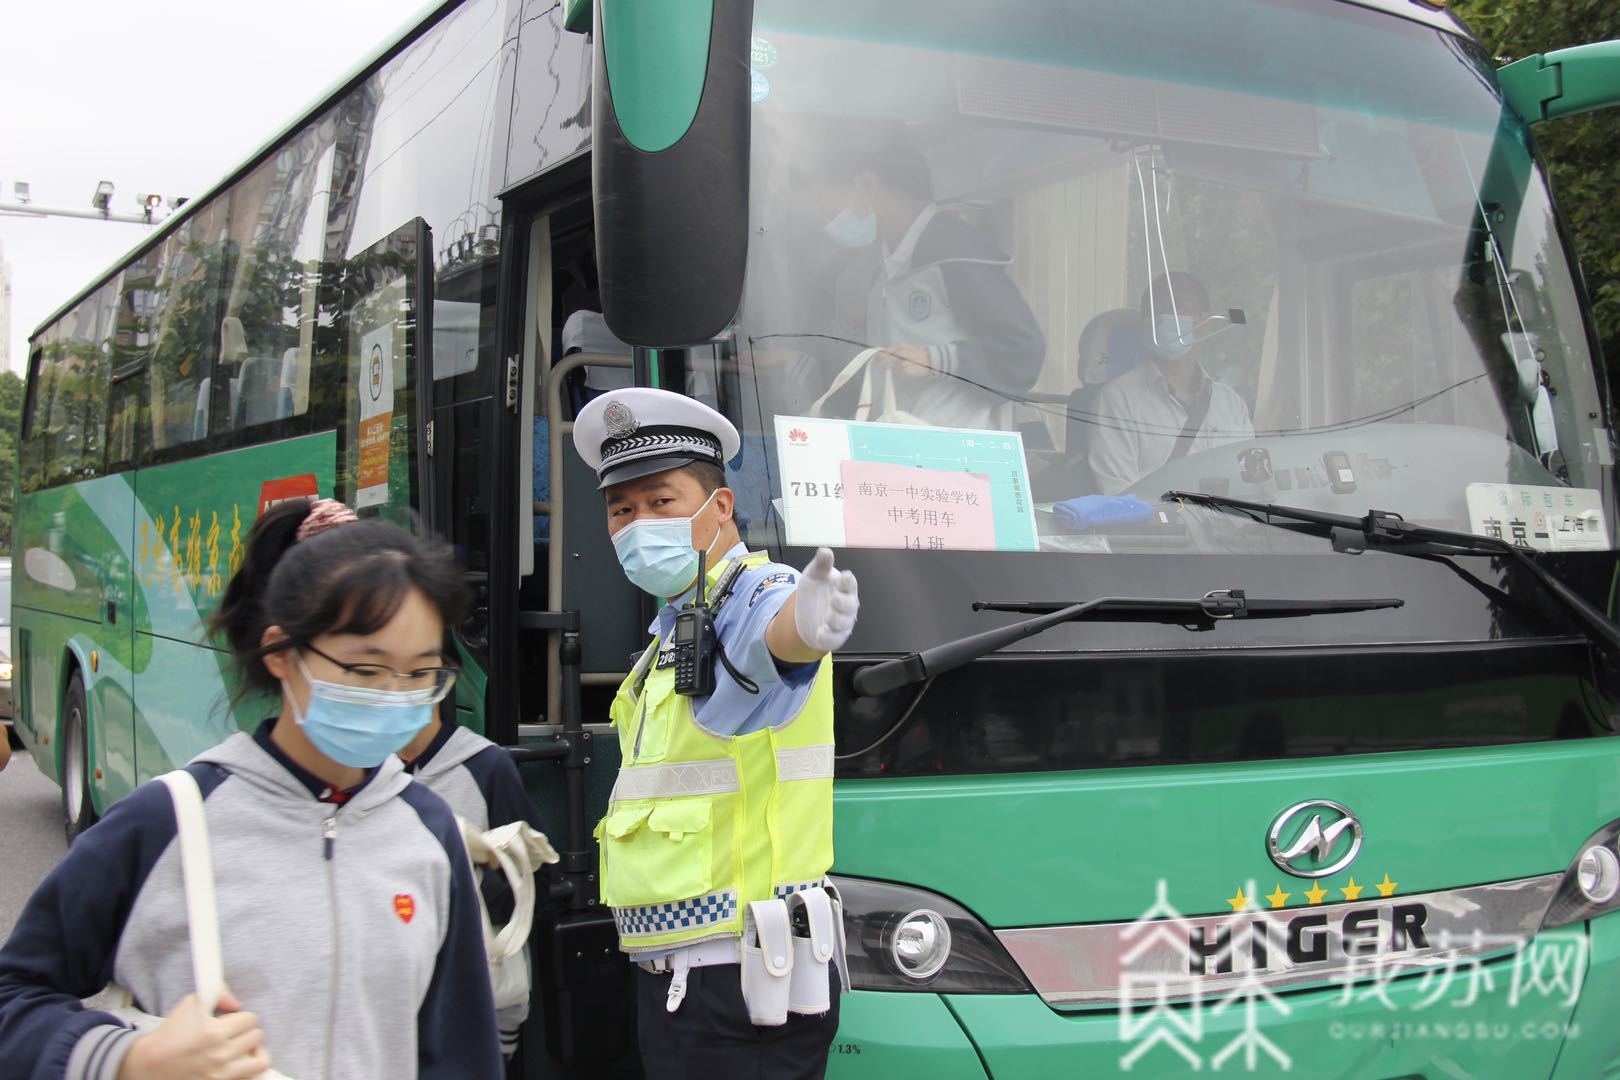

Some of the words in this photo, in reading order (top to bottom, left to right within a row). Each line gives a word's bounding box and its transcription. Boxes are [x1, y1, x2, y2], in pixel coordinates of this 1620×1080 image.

[751, 51, 768, 62] 021
[858, 481, 980, 506] 南京一中实验学校
[888, 506, 956, 528] 中考用车
[1189, 903, 1430, 977] HIGER
